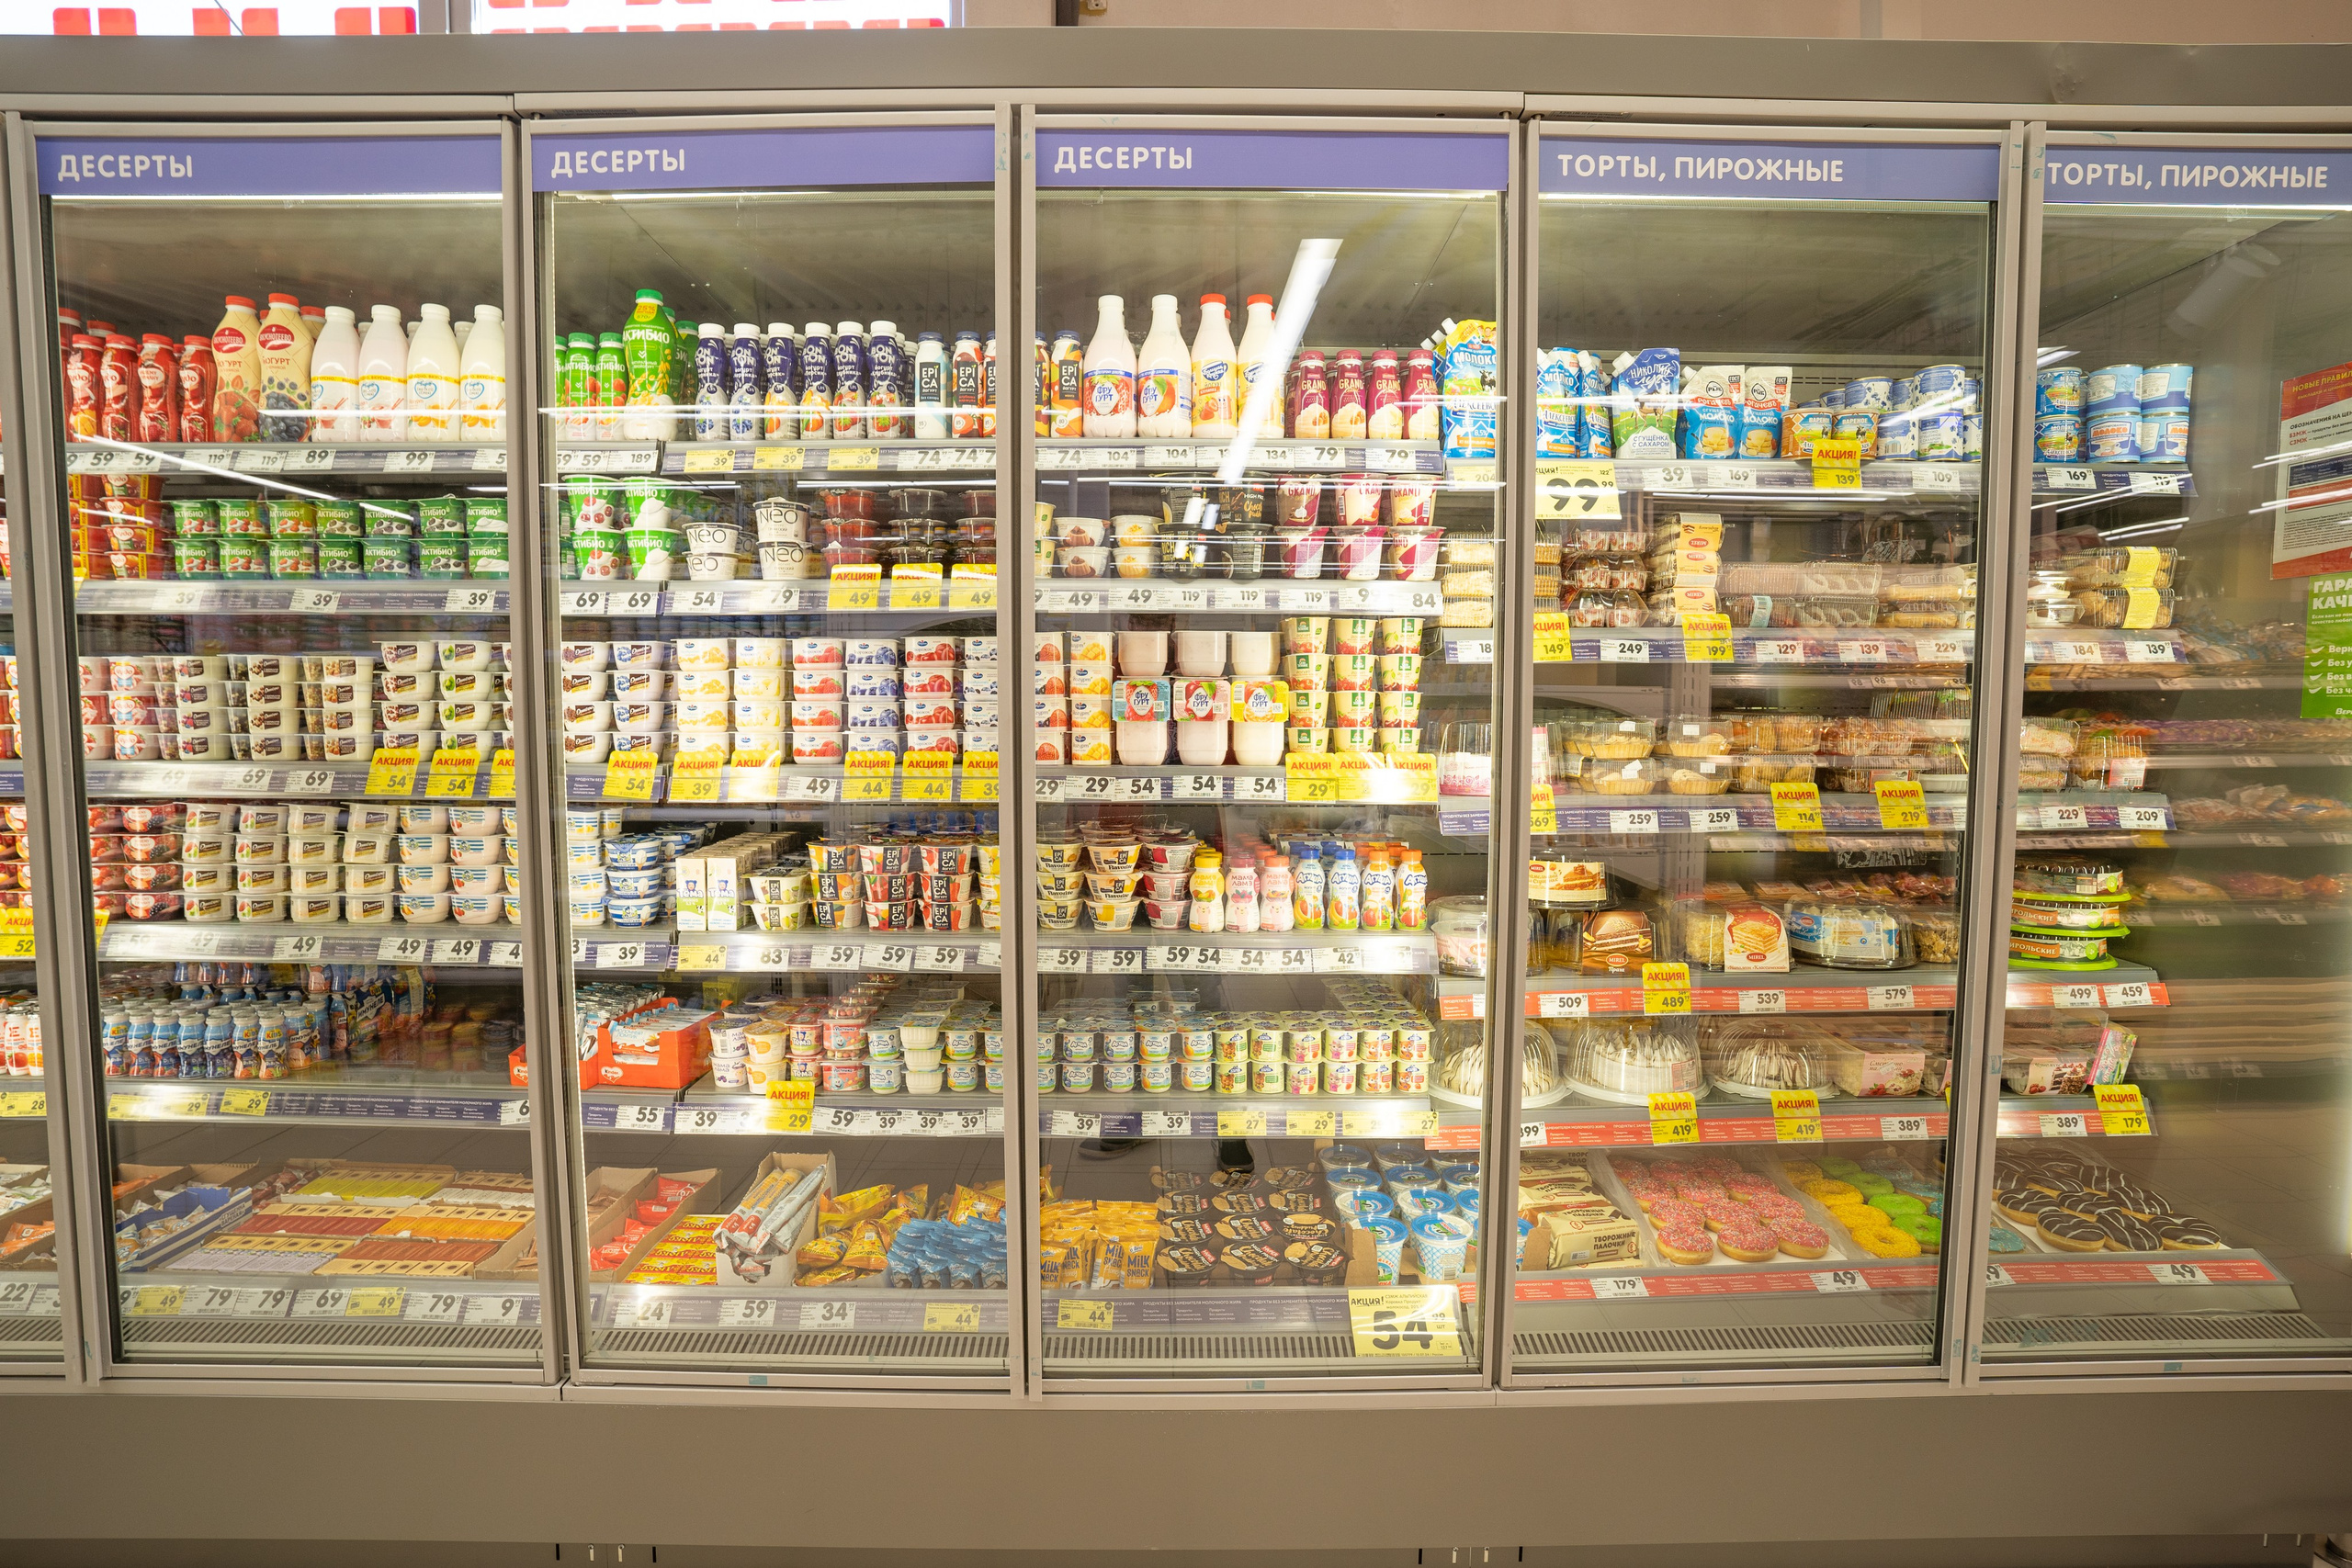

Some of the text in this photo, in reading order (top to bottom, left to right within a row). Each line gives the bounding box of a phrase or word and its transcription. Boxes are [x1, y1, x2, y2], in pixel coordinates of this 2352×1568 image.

[551, 148, 687, 177] ДЕСЕРТЫ
[1054, 146, 1193, 174] ДЕСЕРТЫ
[58, 152, 196, 181] ДЕСЕРТЫ
[1557, 154, 1843, 182] ТОРТЫ, ПИРОЖНЫЕ
[2047, 163, 2328, 190] ТОРТЫ, ПИРОЖНЫЕ
[1301, 379, 1325, 390] GRAND
[2292, 378, 2320, 392] НОВЫЕ
[2290, 417, 2332, 430] ОБОЗНАЧЕНИЯ
[209, 454, 225, 463] 119
[305, 451, 329, 463] 89
[917, 451, 942, 464] 74
[1057, 450, 1081, 463] 74
[1314, 446, 1338, 460] 79
[1816, 449, 1856, 460] АКЦИЯ!
[90, 453, 114, 466] 59
[405, 453, 428, 466] 99
[582, 454, 602, 466] 59
[714, 457, 728, 466] 39
[1662, 467, 1684, 482] 39
[1836, 474, 1855, 484] 139
[2066, 470, 2087, 480] 169
[835, 571, 876, 581] АКЦИЯ!
[312, 593, 333, 606] 39
[469, 592, 488, 605] 39
[576, 591, 599, 607] 69
[692, 592, 716, 606] 54
[849, 592, 870, 604] 49
[1127, 589, 1152, 604] 49
[1305, 592, 1322, 603] 119
[1413, 593, 1436, 608] 84
[2312, 596, 2352, 610] КАЧ
[1533, 622, 1565, 631] КЦИЯ!
[1687, 622, 1727, 632] АКЦИЯ!
[1619, 643, 1643, 654] 249
[1706, 646, 1725, 656] 199
[1860, 644, 1879, 654] 139
[2073, 645, 2094, 655] 184
[376, 756, 415, 766] АКЦИЯ!
[435, 758, 474, 767] АКЦИЯ!
[613, 761, 652, 770] АКЦИЯ!
[679, 761, 718, 769] АКЦИЯ!
[850, 760, 890, 769] АКЦИЯ!
[908, 760, 948, 769] АКЦИЯ!
[1291, 761, 1331, 771] АКЦИЯ!
[305, 772, 328, 786] 69
[1085, 777, 1109, 793] 29
[1192, 775, 1216, 791] 54
[806, 779, 830, 793] 49
[1308, 784, 1328, 796] 29
[1777, 791, 1815, 800] АКЦИЯ!
[1881, 789, 1919, 798] АКЦИЯ!
[1708, 812, 1730, 823] 259
[1901, 811, 1920, 822] 219
[2058, 809, 2079, 819] 229
[292, 936, 316, 952] 49
[397, 939, 421, 954] 49
[618, 946, 638, 960] 39
[705, 954, 719, 964] 44
[882, 946, 906, 963] 59
[1112, 951, 1136, 966] 59
[1198, 949, 1221, 963] 54
[1282, 951, 1305, 964] 54
[1647, 972, 1687, 981] АКЦИЯ!
[1885, 988, 1906, 999] 579
[2121, 986, 2143, 998] 459
[1558, 997, 1581, 1008] 509
[1662, 997, 1684, 1008] 489
[1758, 993, 1779, 1004] 539
[771, 1089, 809, 1100] АКЦИЯ!
[2101, 1092, 2138, 1104] АКЦИЯ!
[31, 1100, 45, 1110] 28
[247, 1099, 261, 1109] 29
[1654, 1101, 1691, 1111] АКЦИЯ!
[1777, 1100, 1815, 1109] АКЦИЯ!
[636, 1106, 658, 1122] 55
[831, 1110, 854, 1127] 59
[962, 1116, 978, 1128] 39
[1077, 1118, 1093, 1130] 39
[1246, 1120, 1259, 1129] 27
[1898, 1120, 1920, 1131] 389
[2056, 1117, 2078, 1128] 389
[1672, 1124, 1691, 1136] 419
[1594, 1232, 1636, 1243] ТВОРОЖНЫЕ
[1593, 1241, 1626, 1250] ПАЛОЧКИ
[2171, 1264, 2197, 1278] 49
[1833, 1270, 1855, 1285] 49
[1613, 1280, 1636, 1290] 179
[4, 1283, 28, 1302] 22
[208, 1288, 232, 1305] 79
[316, 1289, 343, 1308] 69
[429, 1294, 456, 1314] 79
[1351, 1296, 1385, 1307] АКЦИЯ!
[742, 1300, 767, 1317] 59
[1089, 1311, 1105, 1323] 44
[1372, 1310, 1433, 1350] 54
